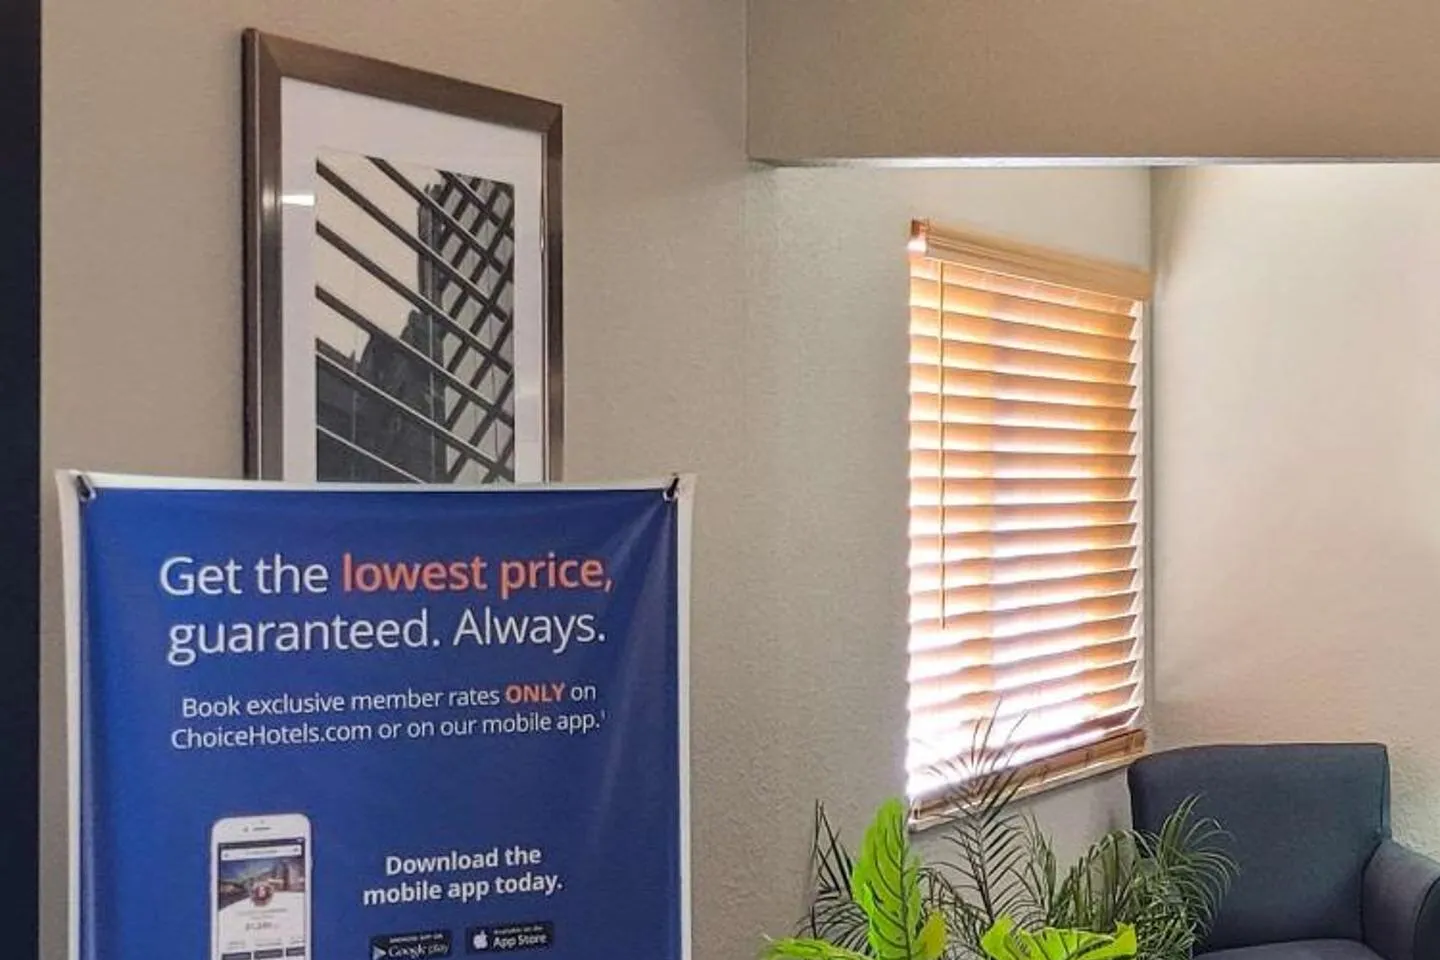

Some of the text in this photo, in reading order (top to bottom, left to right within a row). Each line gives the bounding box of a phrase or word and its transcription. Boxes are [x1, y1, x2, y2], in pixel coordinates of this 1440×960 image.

[159, 551, 613, 600] Get the lowest price,
[167, 605, 606, 667] guaranteed. Always.
[182, 682, 596, 718] Book exclusive member rates ONLY on
[170, 722, 372, 749] ChoiceHotels.com
[378, 722, 402, 739] or
[407, 722, 434, 738] on
[440, 719, 477, 736] our
[482, 711, 552, 734] mobile
[385, 845, 541, 876] Download the
[363, 871, 564, 905] mobile app today.
[492, 932, 547, 949] App Store
